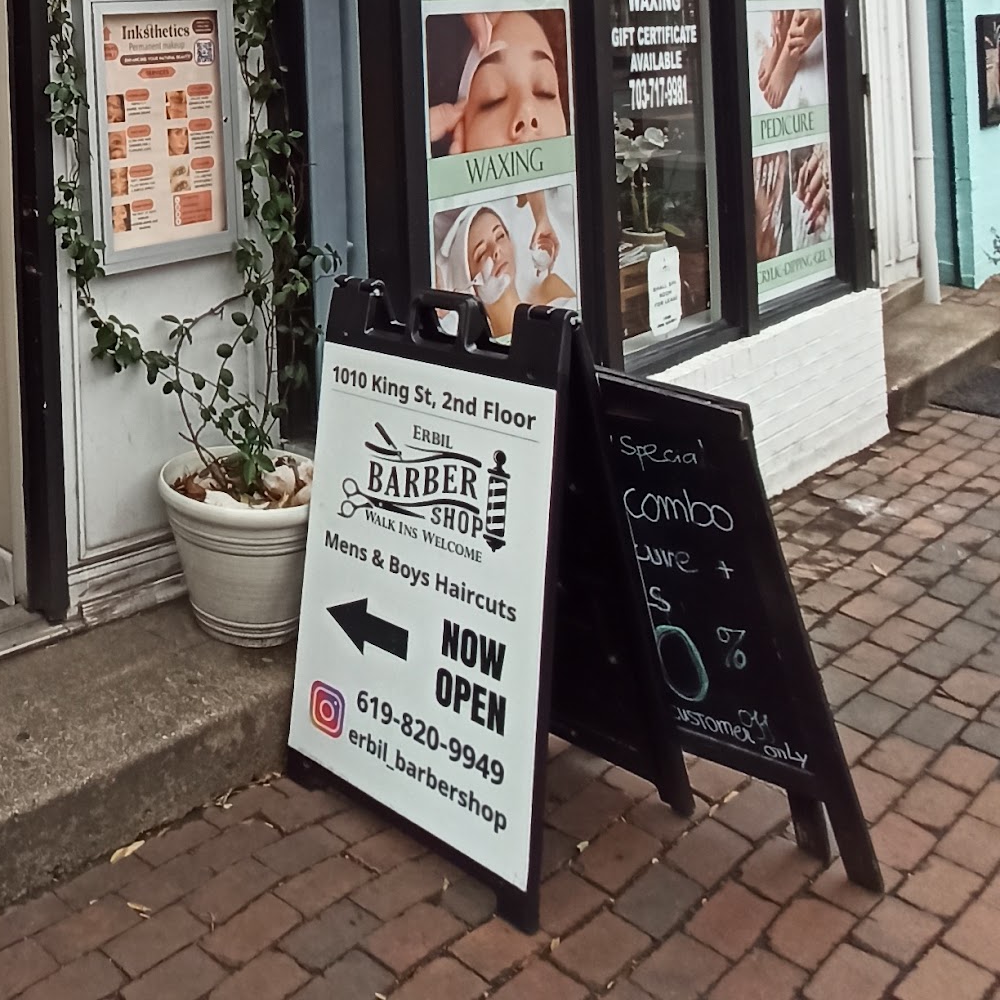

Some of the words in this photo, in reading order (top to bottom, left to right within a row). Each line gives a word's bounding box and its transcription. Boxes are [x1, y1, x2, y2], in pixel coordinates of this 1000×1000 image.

[122, 24, 190, 40] Inksthetics
[611, 27, 635, 47] GIFT
[637, 24, 697, 46] CERTIFICATE
[630, 50, 682, 72] AVAILABLE
[628, 74, 688, 110] 703-717-9981
[760, 111, 815, 140] PEDICURE
[466, 146, 544, 185] WAXING
[332, 365, 367, 389] 1010
[371, 374, 410, 404] King
[414, 384, 436, 409] St,
[442, 391, 477, 417] 2nd
[483, 401, 537, 430] Floor
[412, 424, 454, 449] ERBIL
[367, 460, 478, 500] BARBER
[430, 506, 483, 539] SHOP
[325, 530, 367, 562] Mens
[372, 550, 385, 570] &
[389, 554, 430, 586] Boys
[436, 572, 517, 622] Haircuts
[441, 618, 507, 682] NOW
[435, 667, 507, 737] OPEN
[356, 690, 505, 785] 619-820-9949
[348, 726, 507, 833] erbil_barbershop
